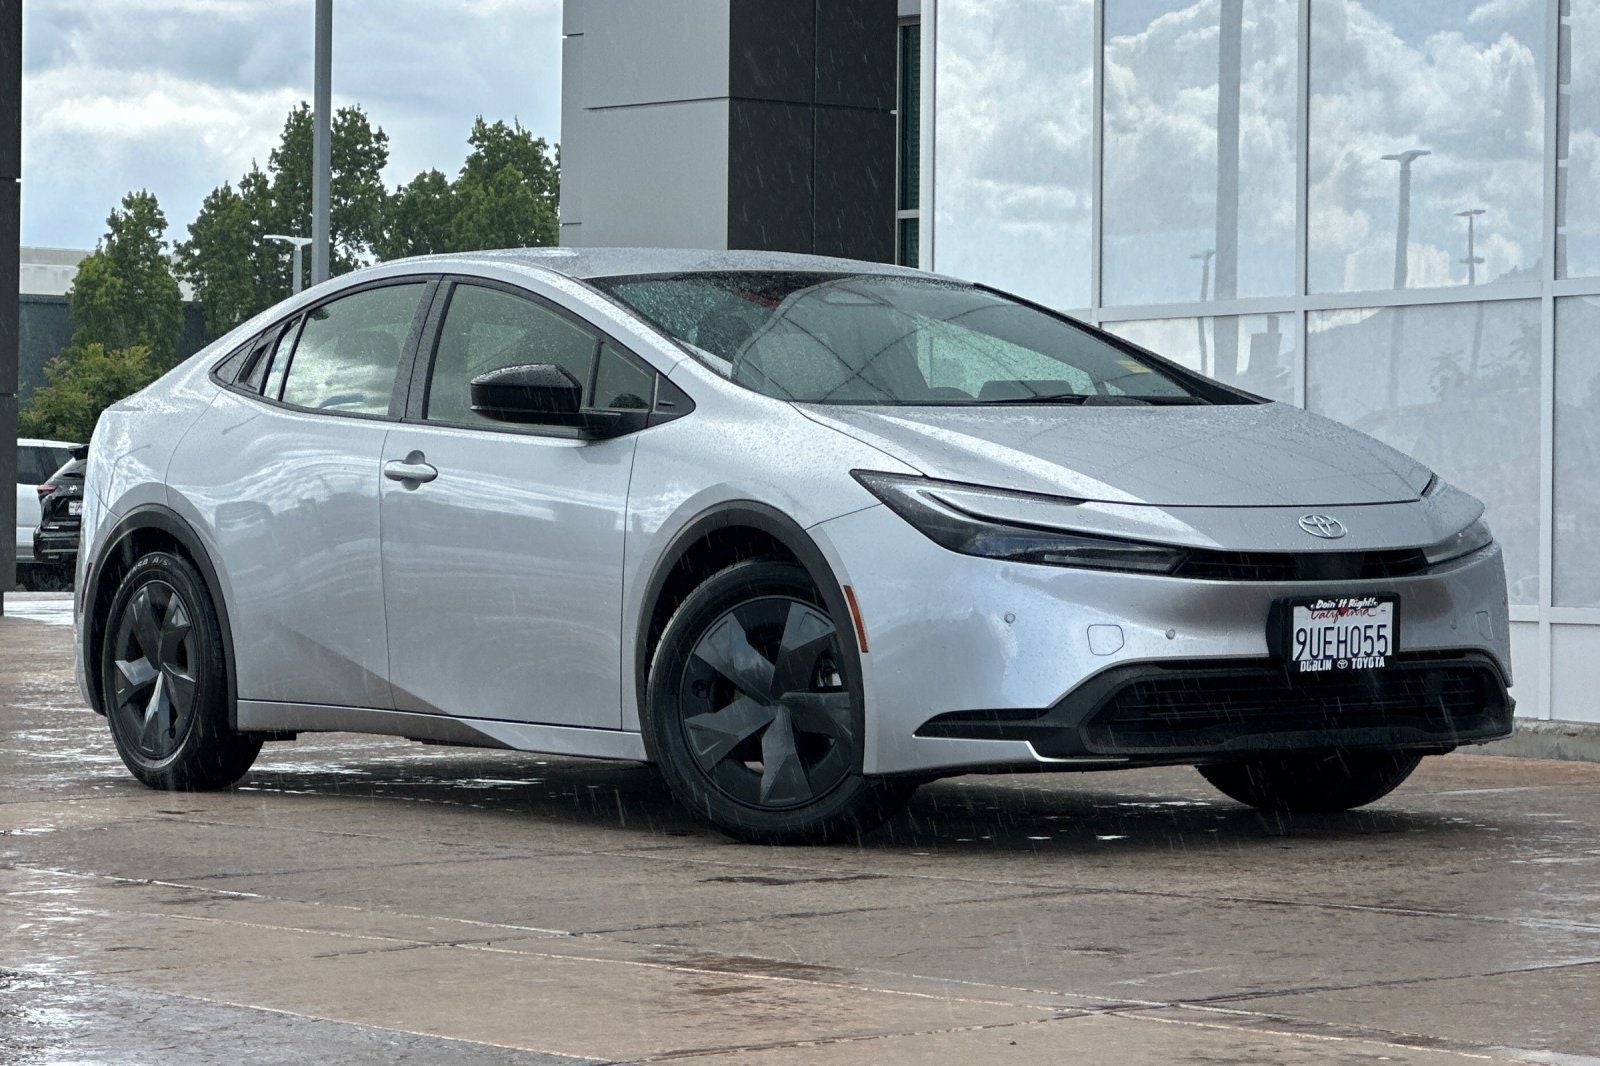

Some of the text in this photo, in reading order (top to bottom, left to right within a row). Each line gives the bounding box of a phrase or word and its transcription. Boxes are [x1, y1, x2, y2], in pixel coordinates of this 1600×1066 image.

[1316, 598, 1338, 609] Doin'
[1338, 598, 1347, 608] It
[1295, 624, 1388, 660] 9UEH055
[1300, 657, 1385, 672] DUBLIN TOYOTA
